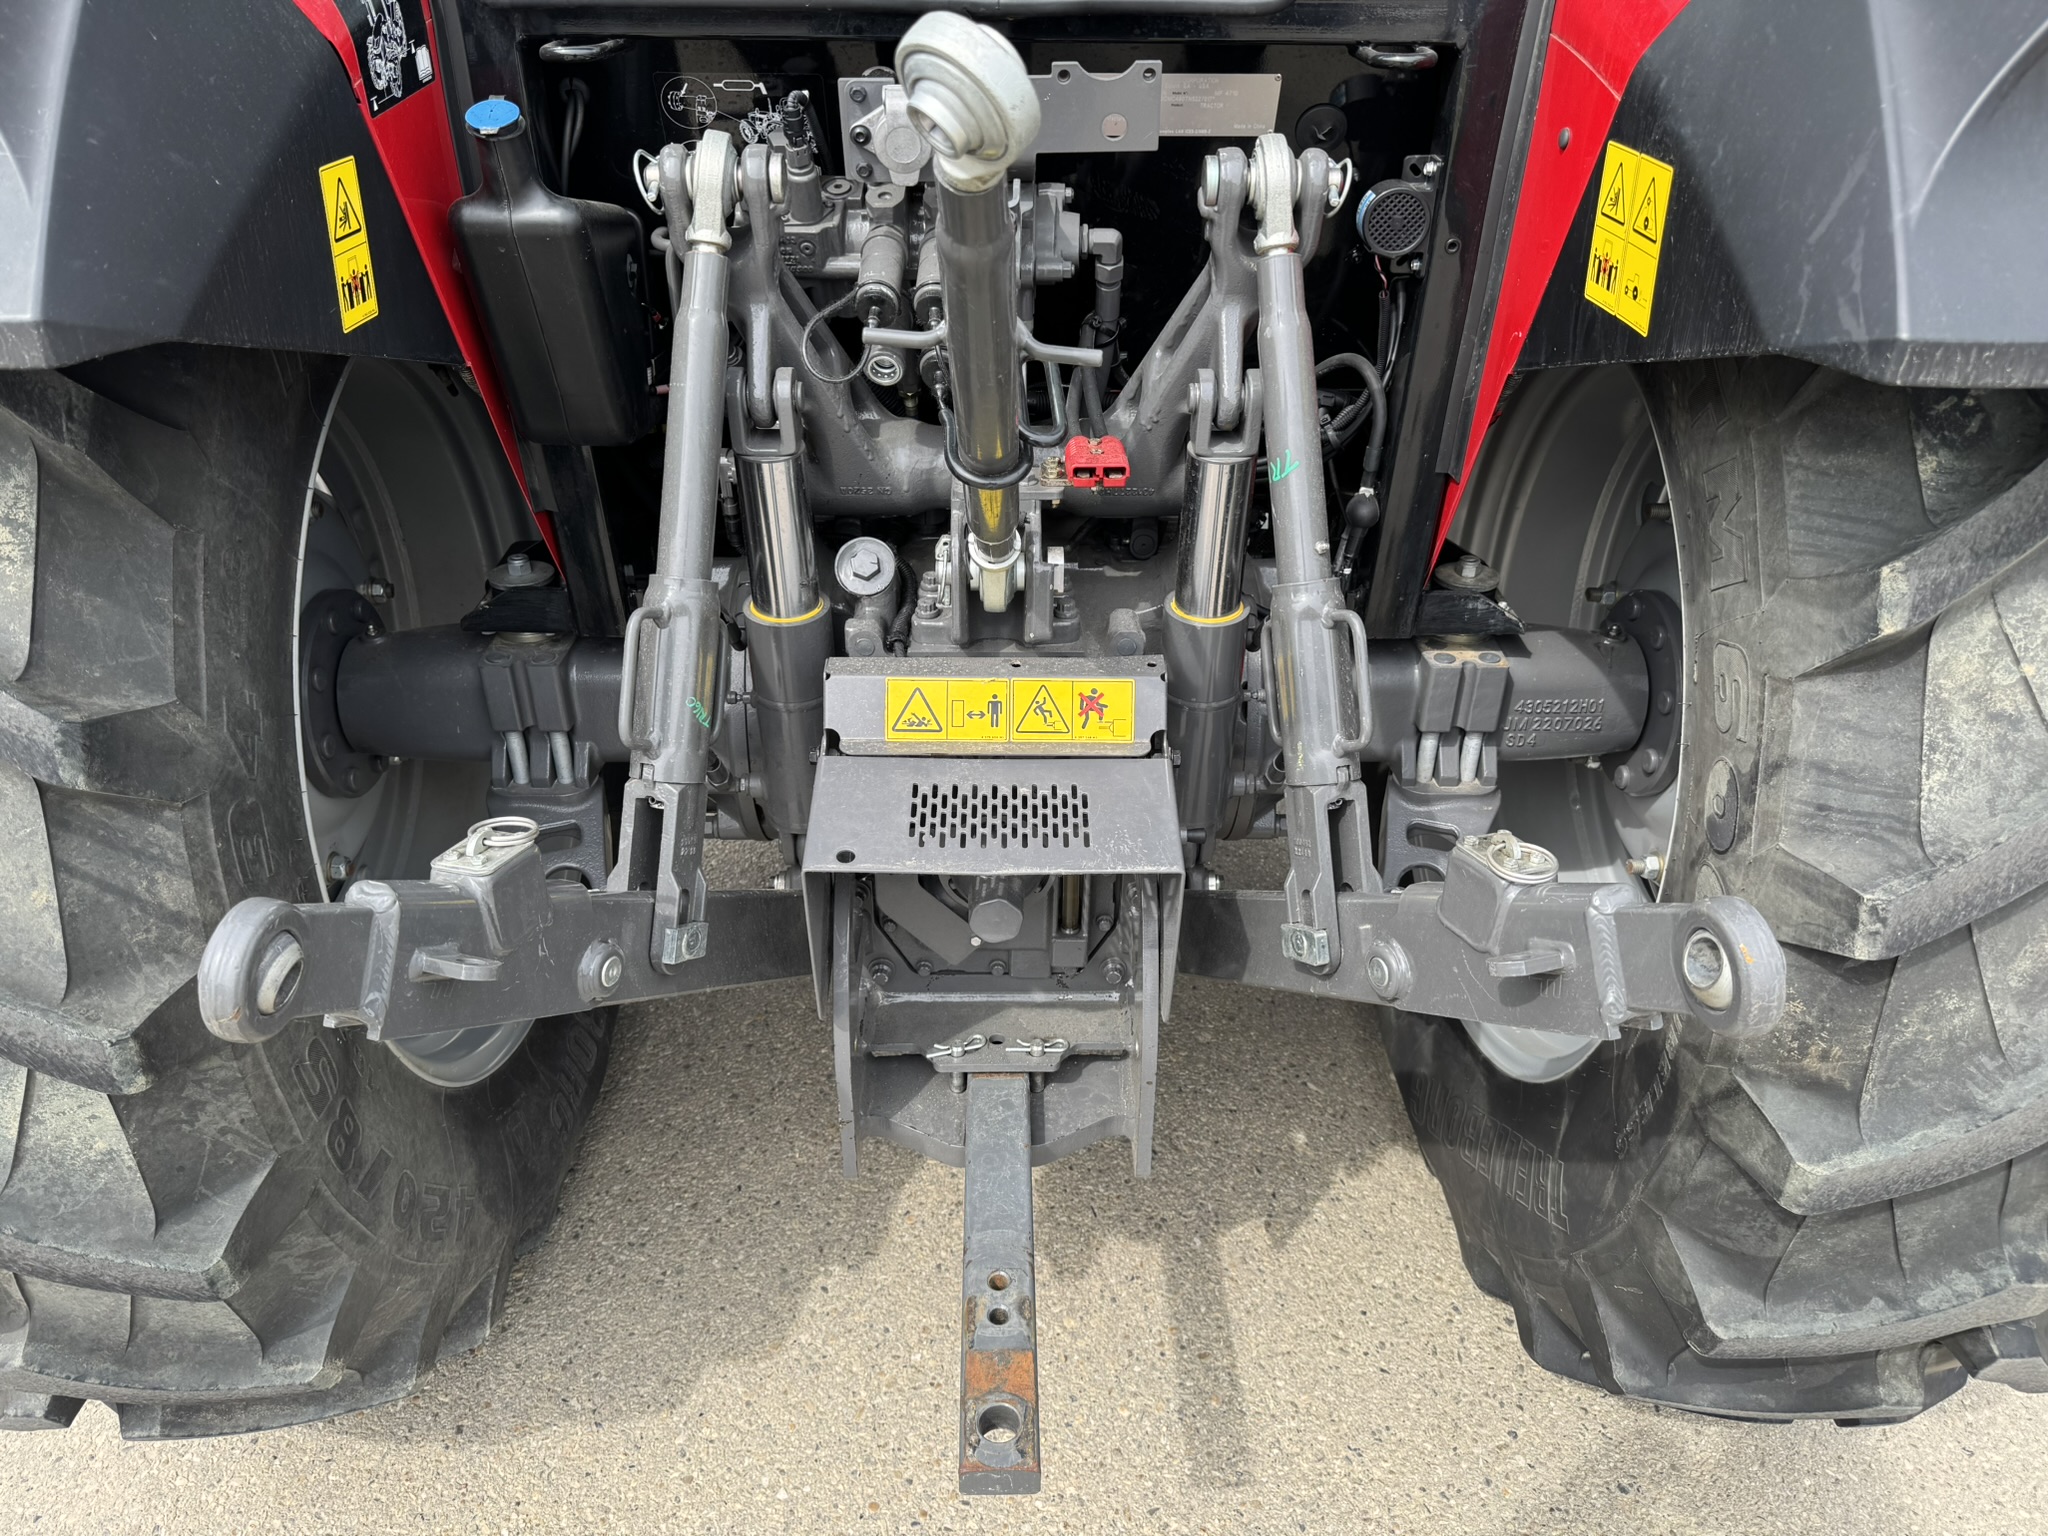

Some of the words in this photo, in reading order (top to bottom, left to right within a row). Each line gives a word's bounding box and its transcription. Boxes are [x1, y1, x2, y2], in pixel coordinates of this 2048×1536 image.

[1513, 697, 1604, 714] 4305212H01
[1504, 732, 1536, 747] SD4
[1409, 1073, 1570, 1235] TRELLEBORG
